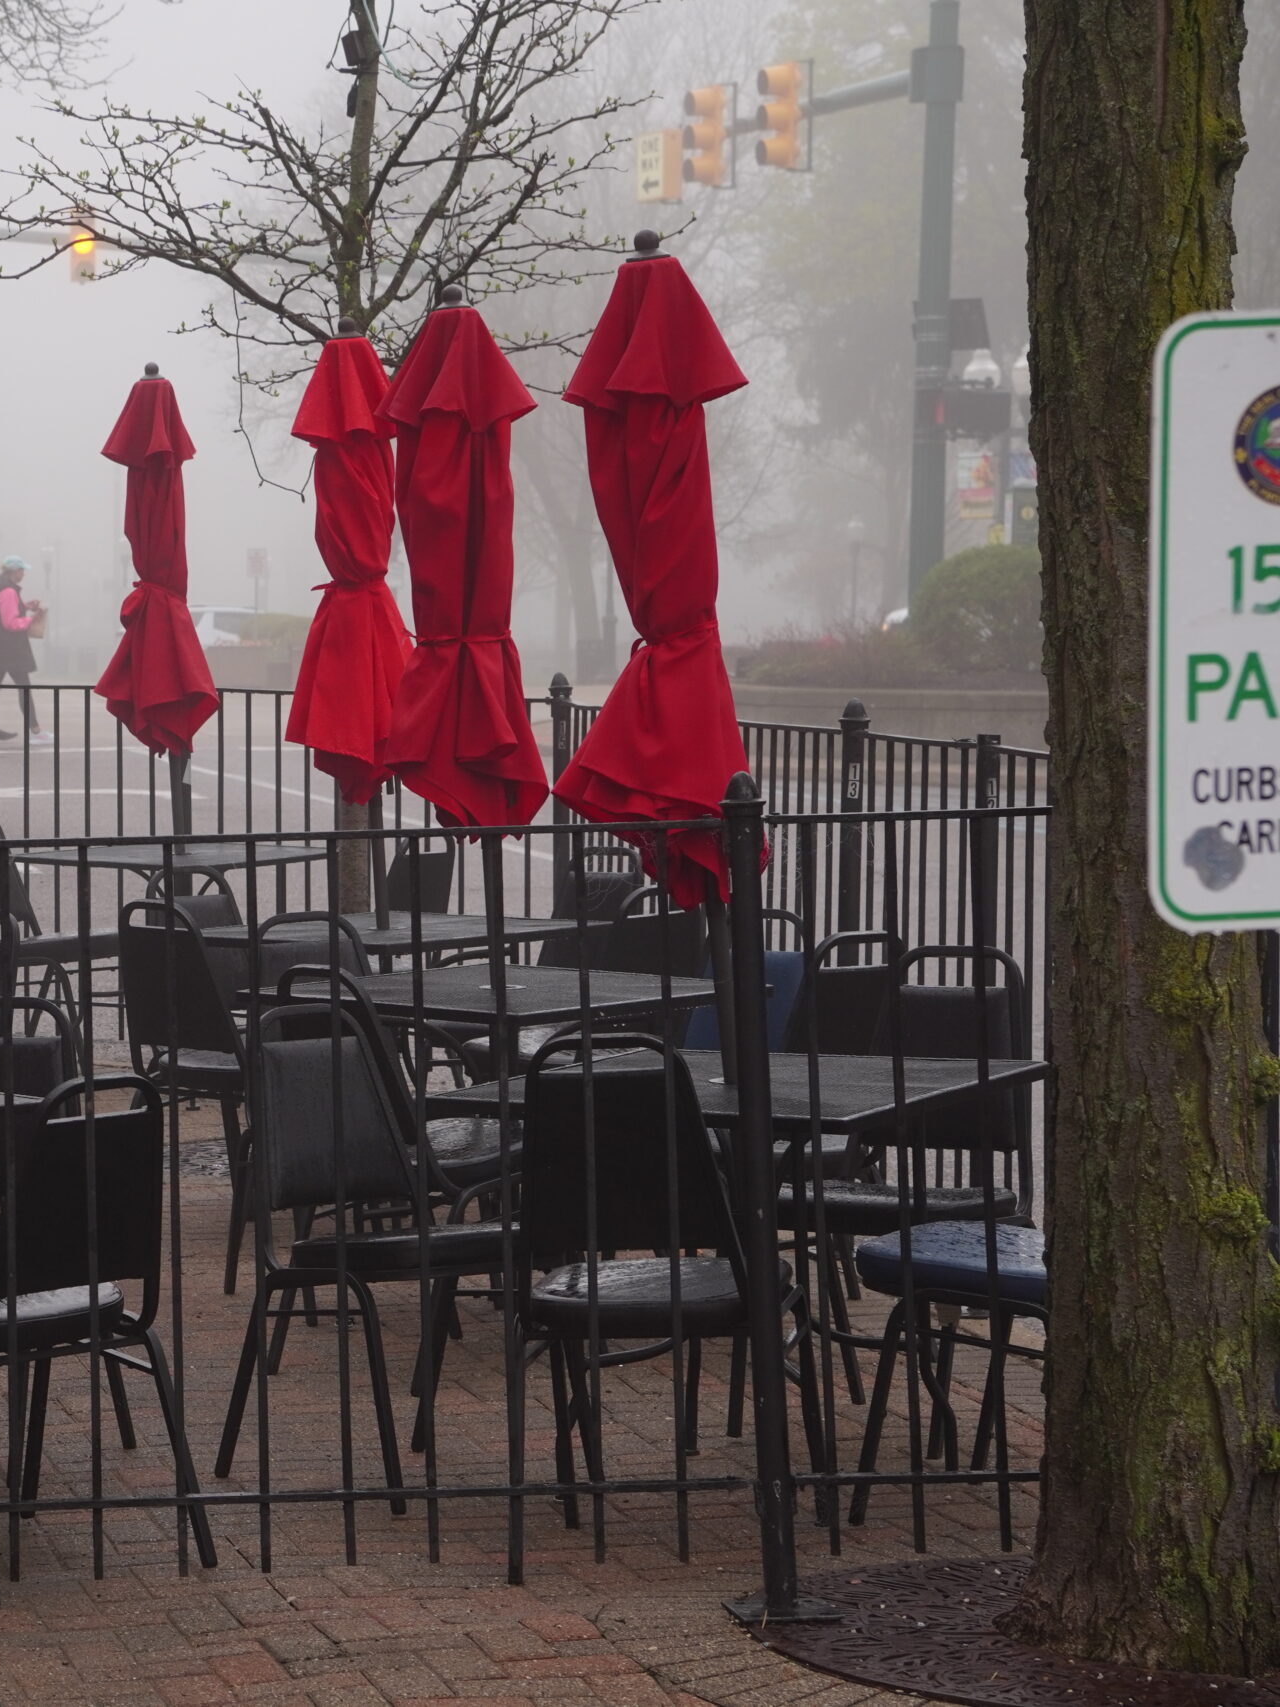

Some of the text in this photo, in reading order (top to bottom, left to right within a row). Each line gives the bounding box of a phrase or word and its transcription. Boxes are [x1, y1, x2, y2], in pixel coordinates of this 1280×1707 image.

[641, 137, 659, 154] ONE
[641, 157, 660, 172] WAY
[1227, 544, 1280, 616] 15
